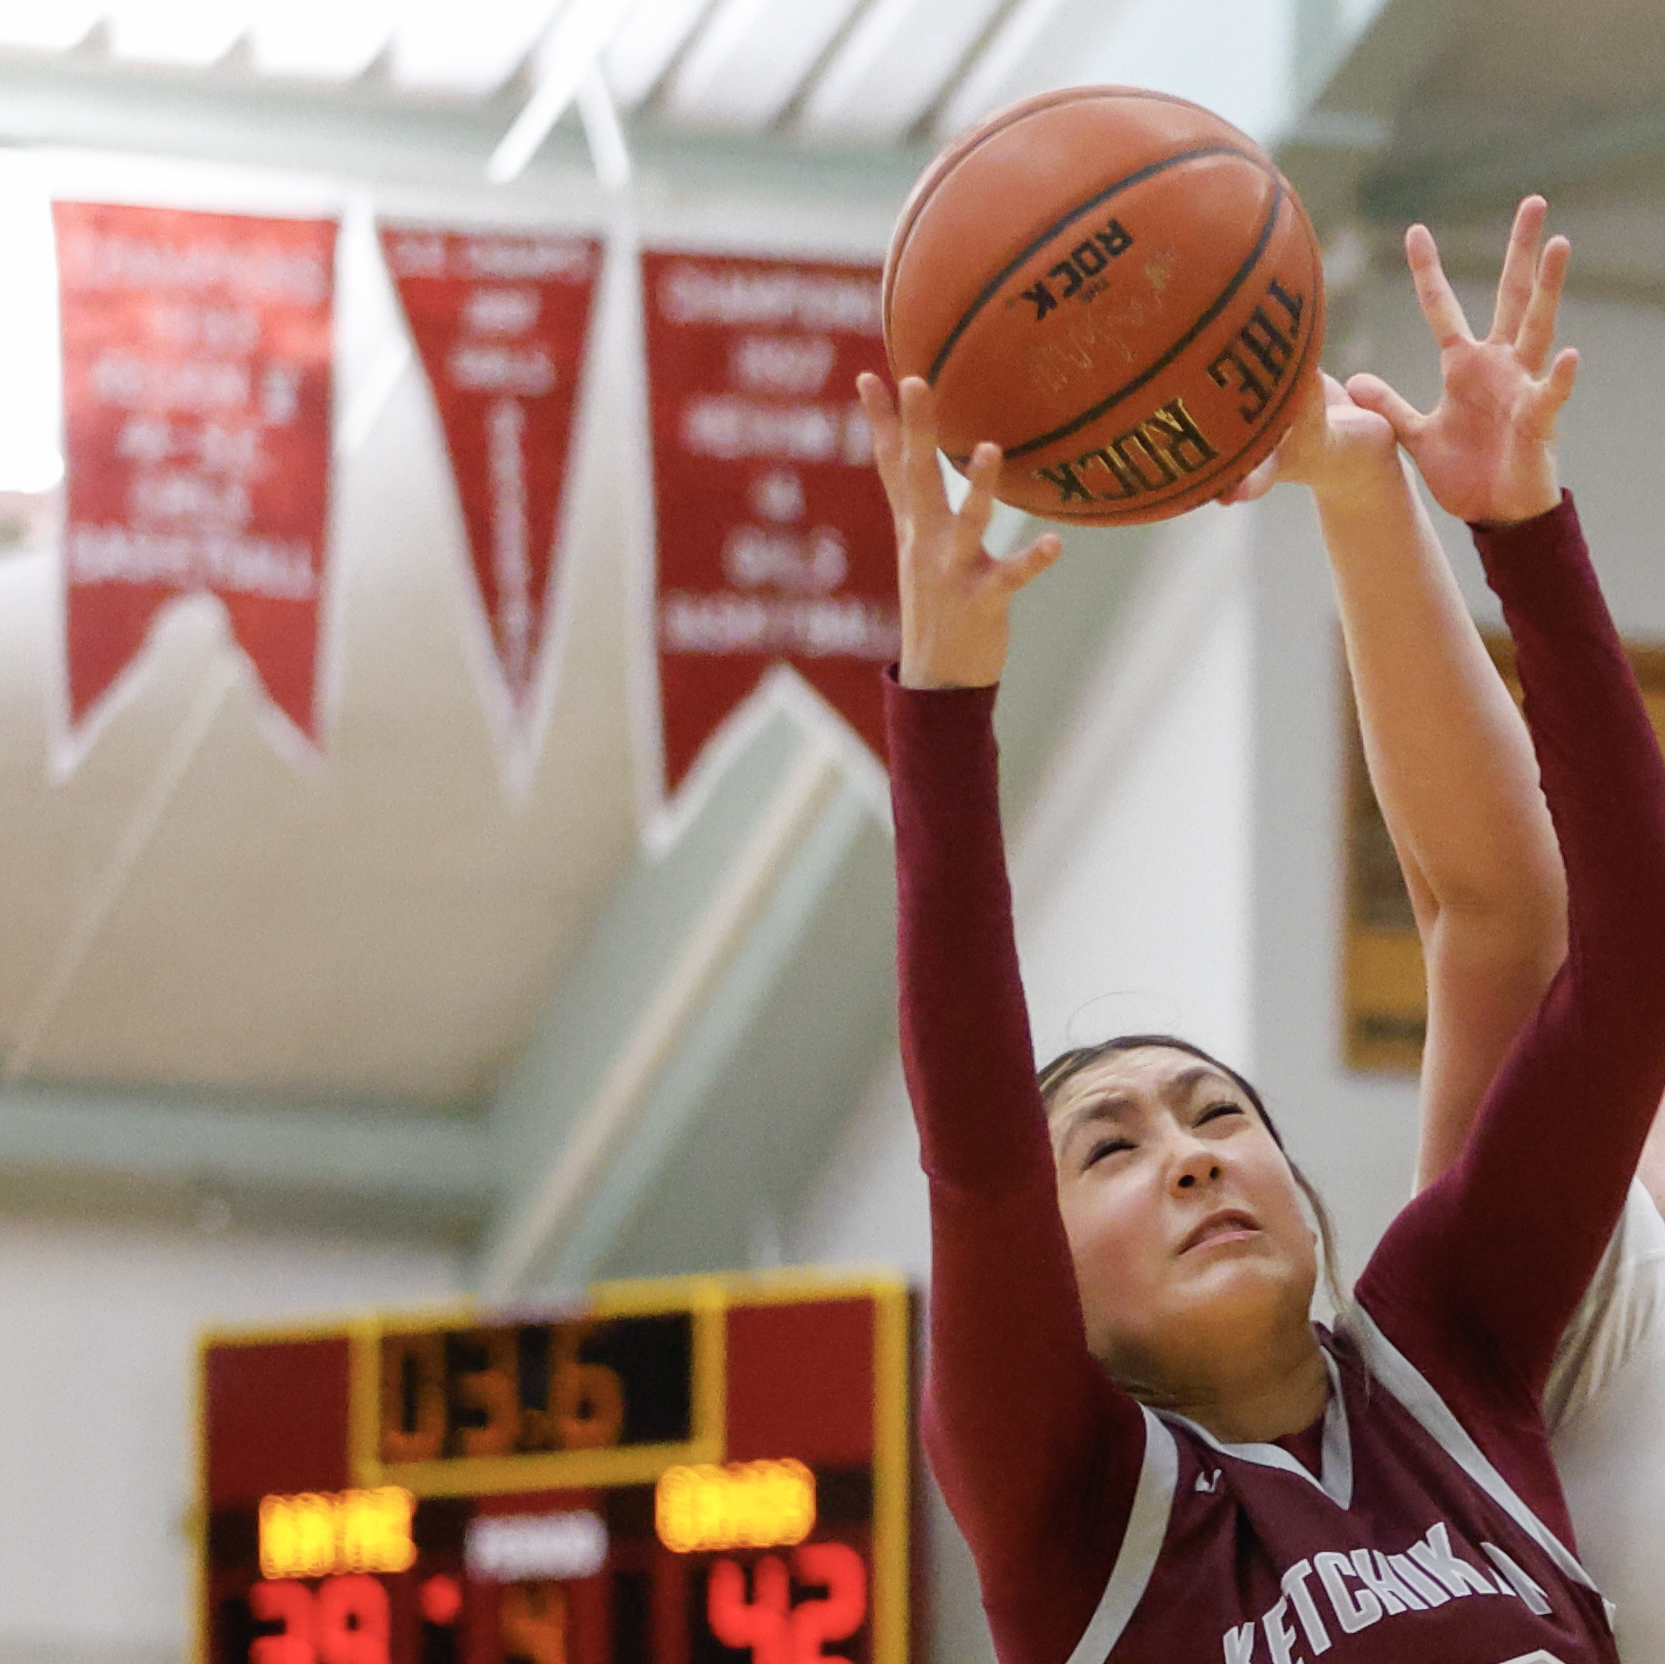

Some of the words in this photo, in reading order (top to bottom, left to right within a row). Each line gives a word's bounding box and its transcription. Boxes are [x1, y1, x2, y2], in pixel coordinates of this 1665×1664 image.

[1020, 218, 1134, 321] ROCK
[1207, 277, 1304, 424] THE
[1038, 397, 1219, 502] ROCK
